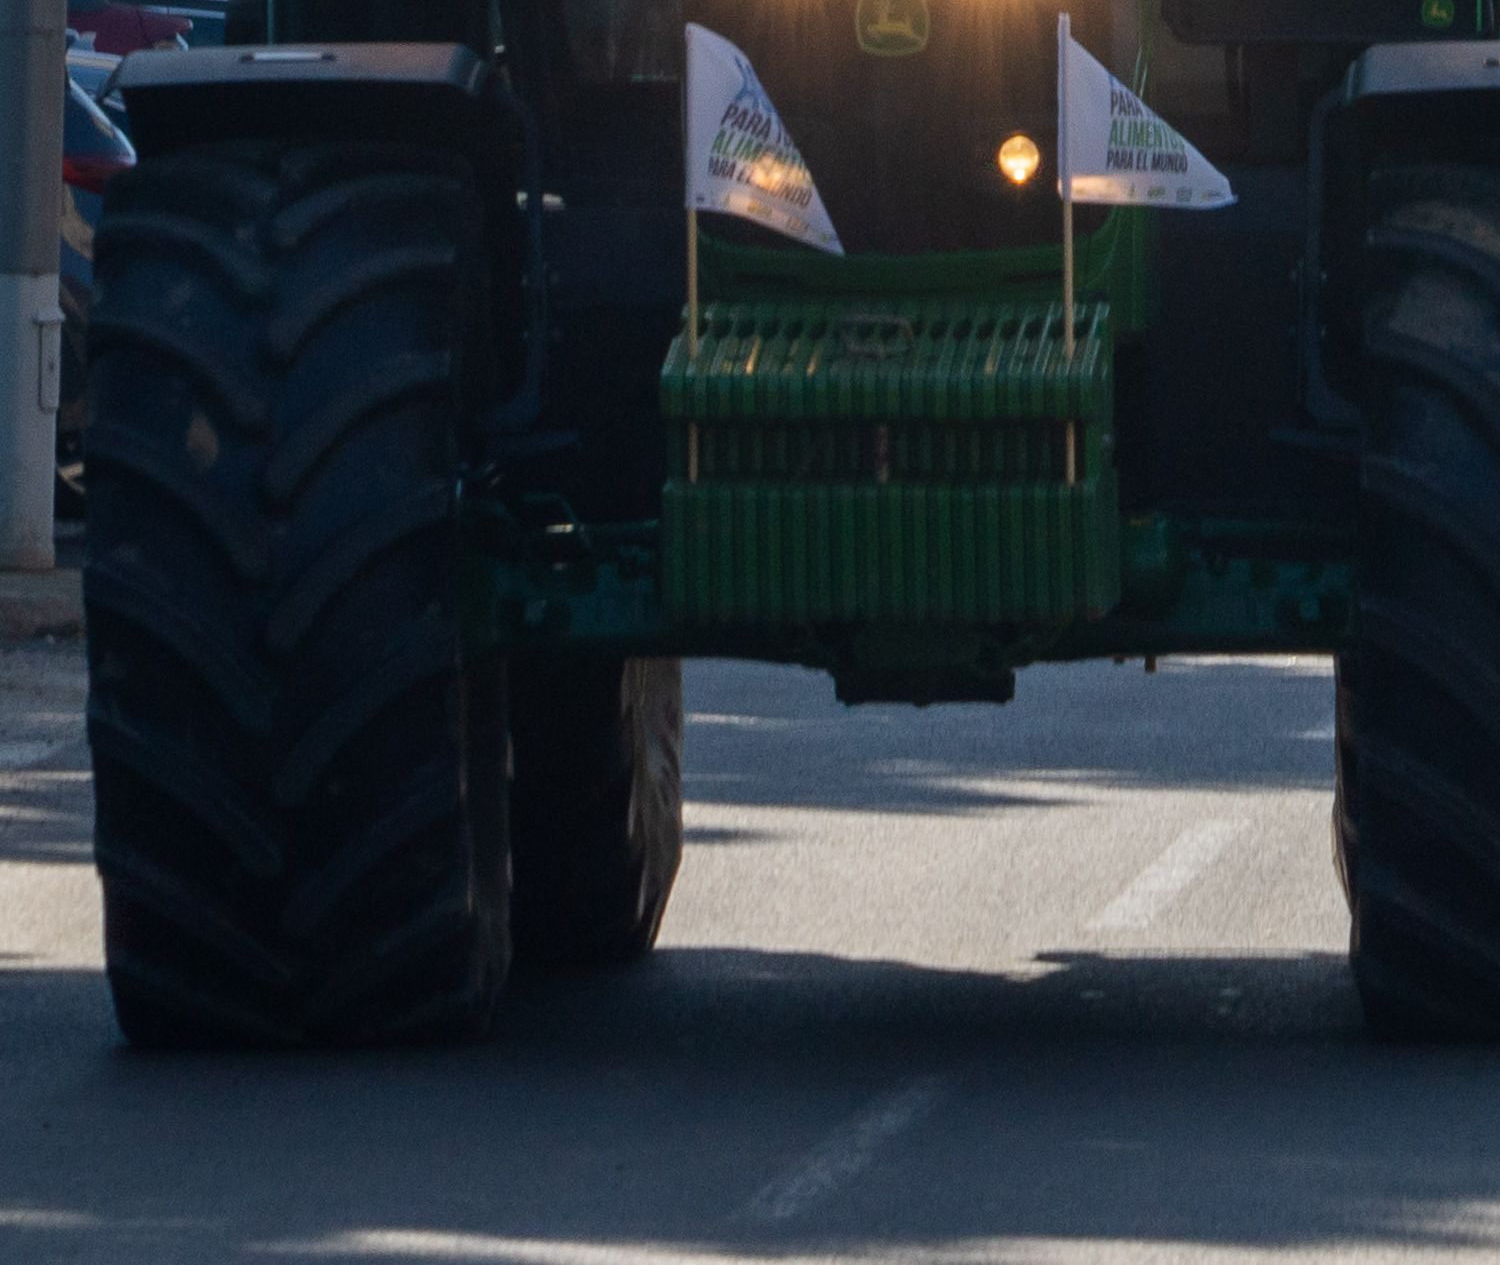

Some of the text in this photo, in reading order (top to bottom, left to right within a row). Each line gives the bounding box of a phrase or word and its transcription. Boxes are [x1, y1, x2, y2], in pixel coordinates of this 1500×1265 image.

[720, 102, 772, 141] PARA
[1106, 149, 1189, 174] PARA EL MUNDO
